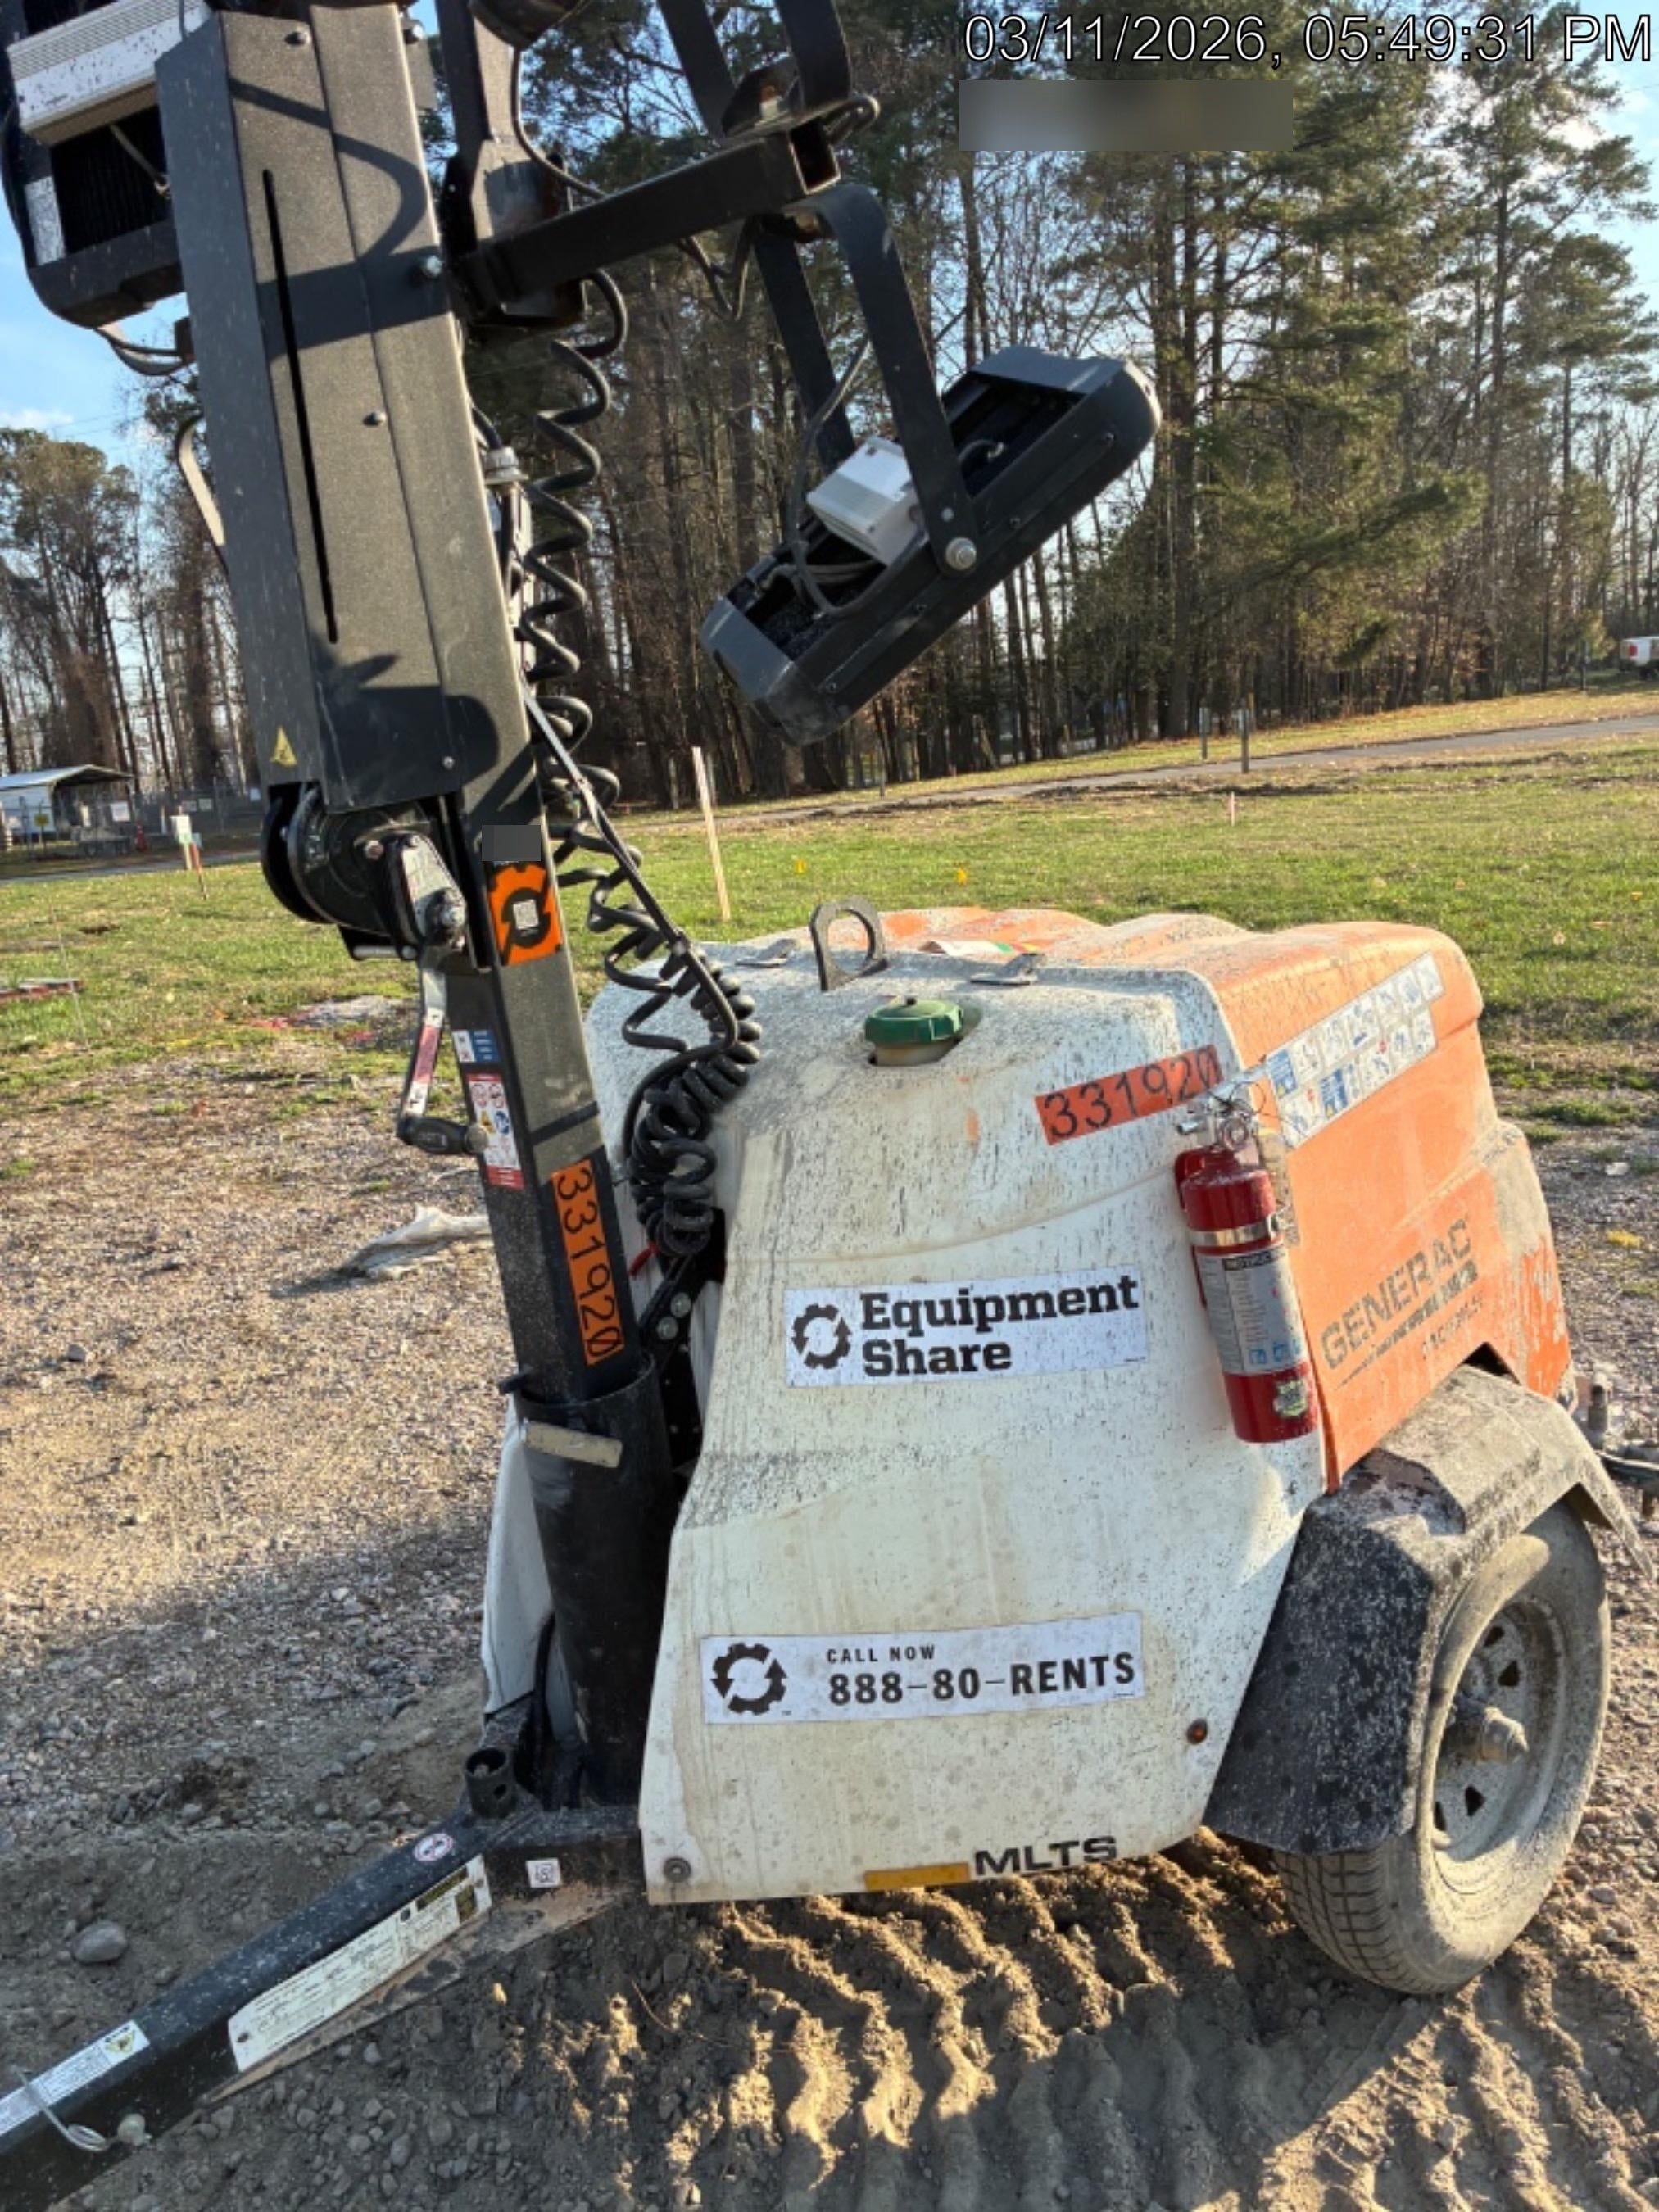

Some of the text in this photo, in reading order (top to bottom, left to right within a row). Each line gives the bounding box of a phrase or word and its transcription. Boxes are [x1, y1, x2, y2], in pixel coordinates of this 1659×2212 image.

[1045, 1045, 1222, 1138] 331920
[557, 1167, 623, 1357] 331920
[860, 1275, 1139, 1337] Equipment
[1321, 1218, 1471, 1369] GENERAC
[862, 1339, 1012, 1376] Share
[827, 1644, 936, 1664] CALL NOW
[828, 1652, 1135, 1706] 888-80-RENTS
[975, 1835, 1117, 1875] MLTS
